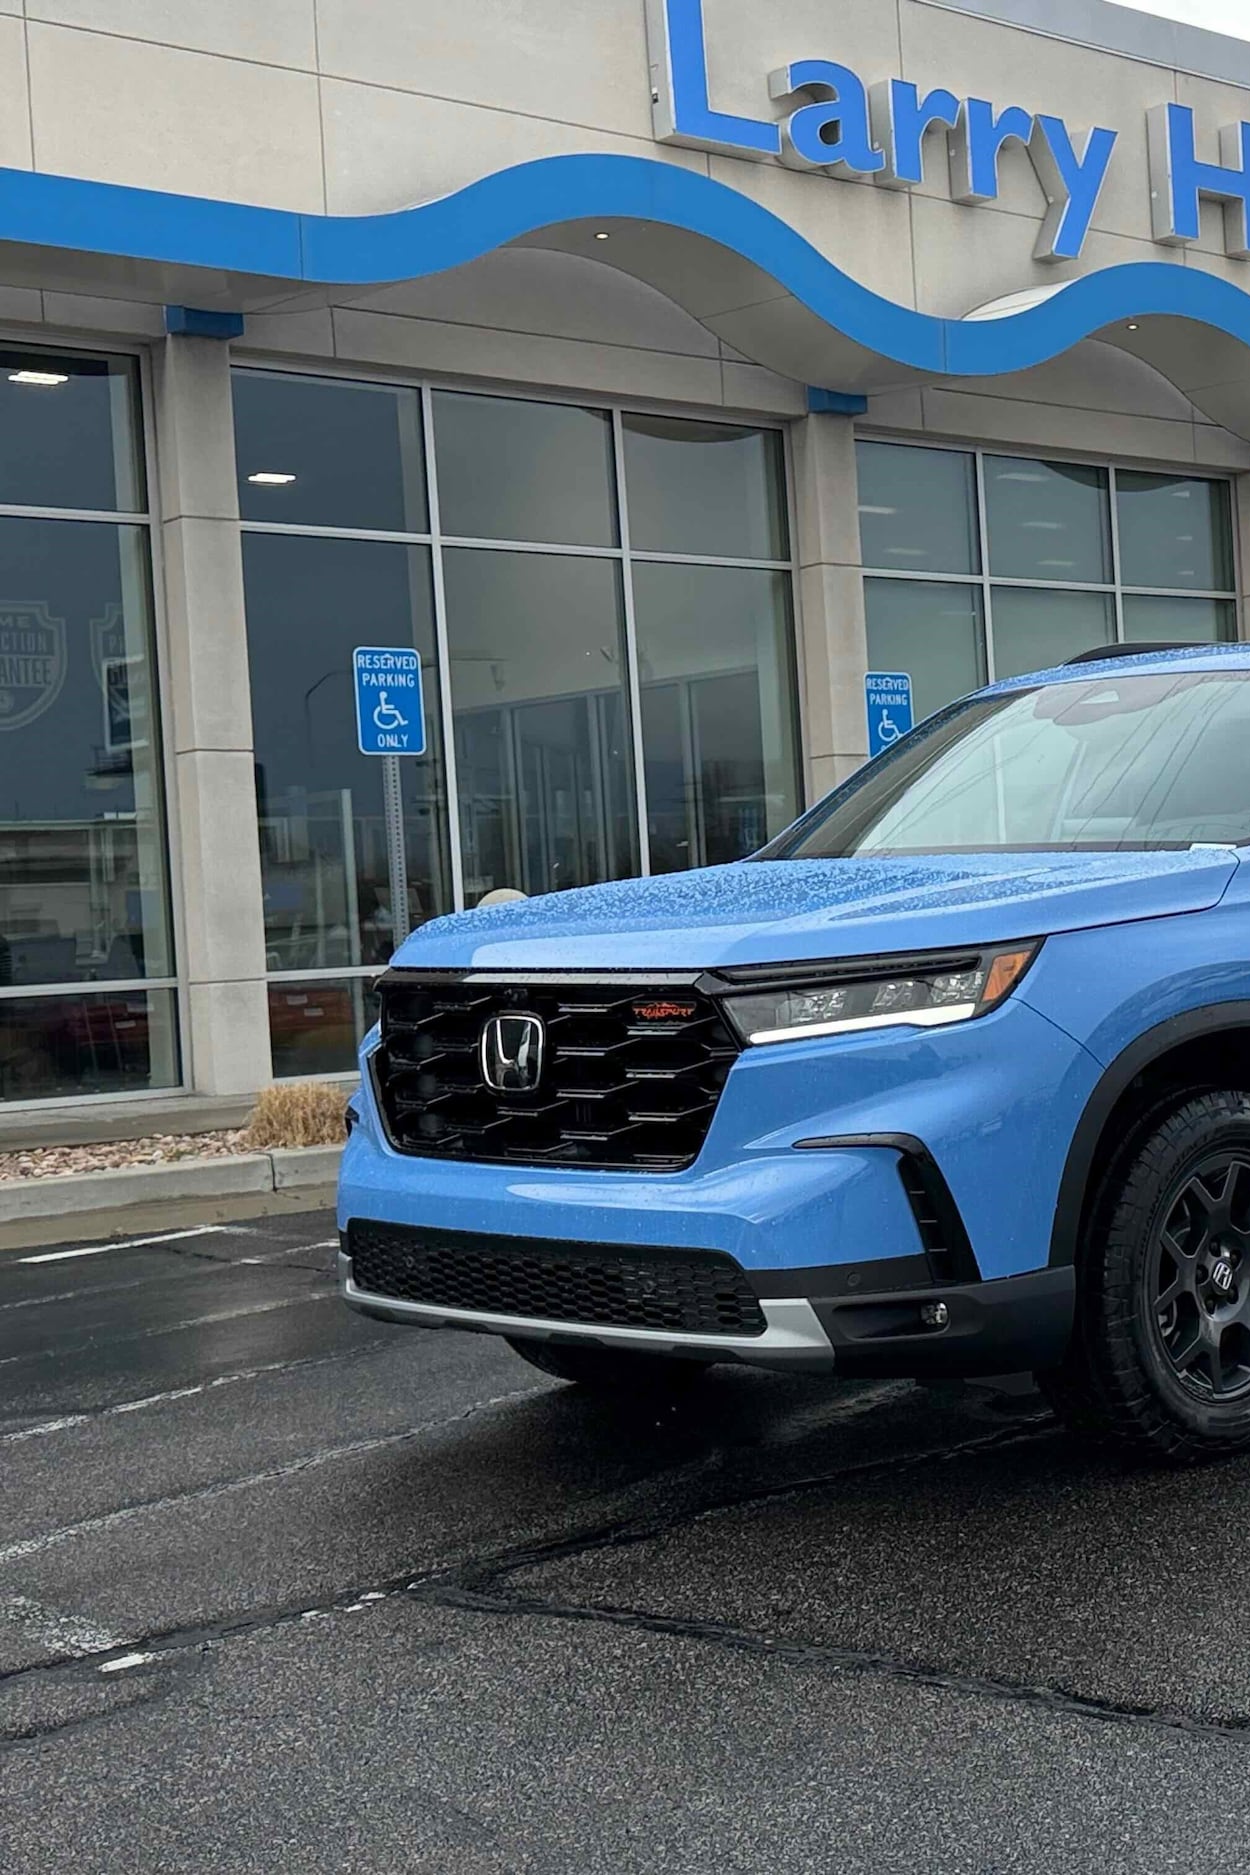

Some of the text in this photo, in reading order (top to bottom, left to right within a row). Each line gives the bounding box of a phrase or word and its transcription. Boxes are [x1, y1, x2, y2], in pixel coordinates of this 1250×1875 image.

[664, 0, 1119, 261] Larry
[357, 654, 417, 670] RESERVED
[362, 673, 416, 688] PARKING
[866, 678, 910, 691] RESERVED
[869, 693, 908, 706] PARKING
[377, 733, 409, 748] ONLY
